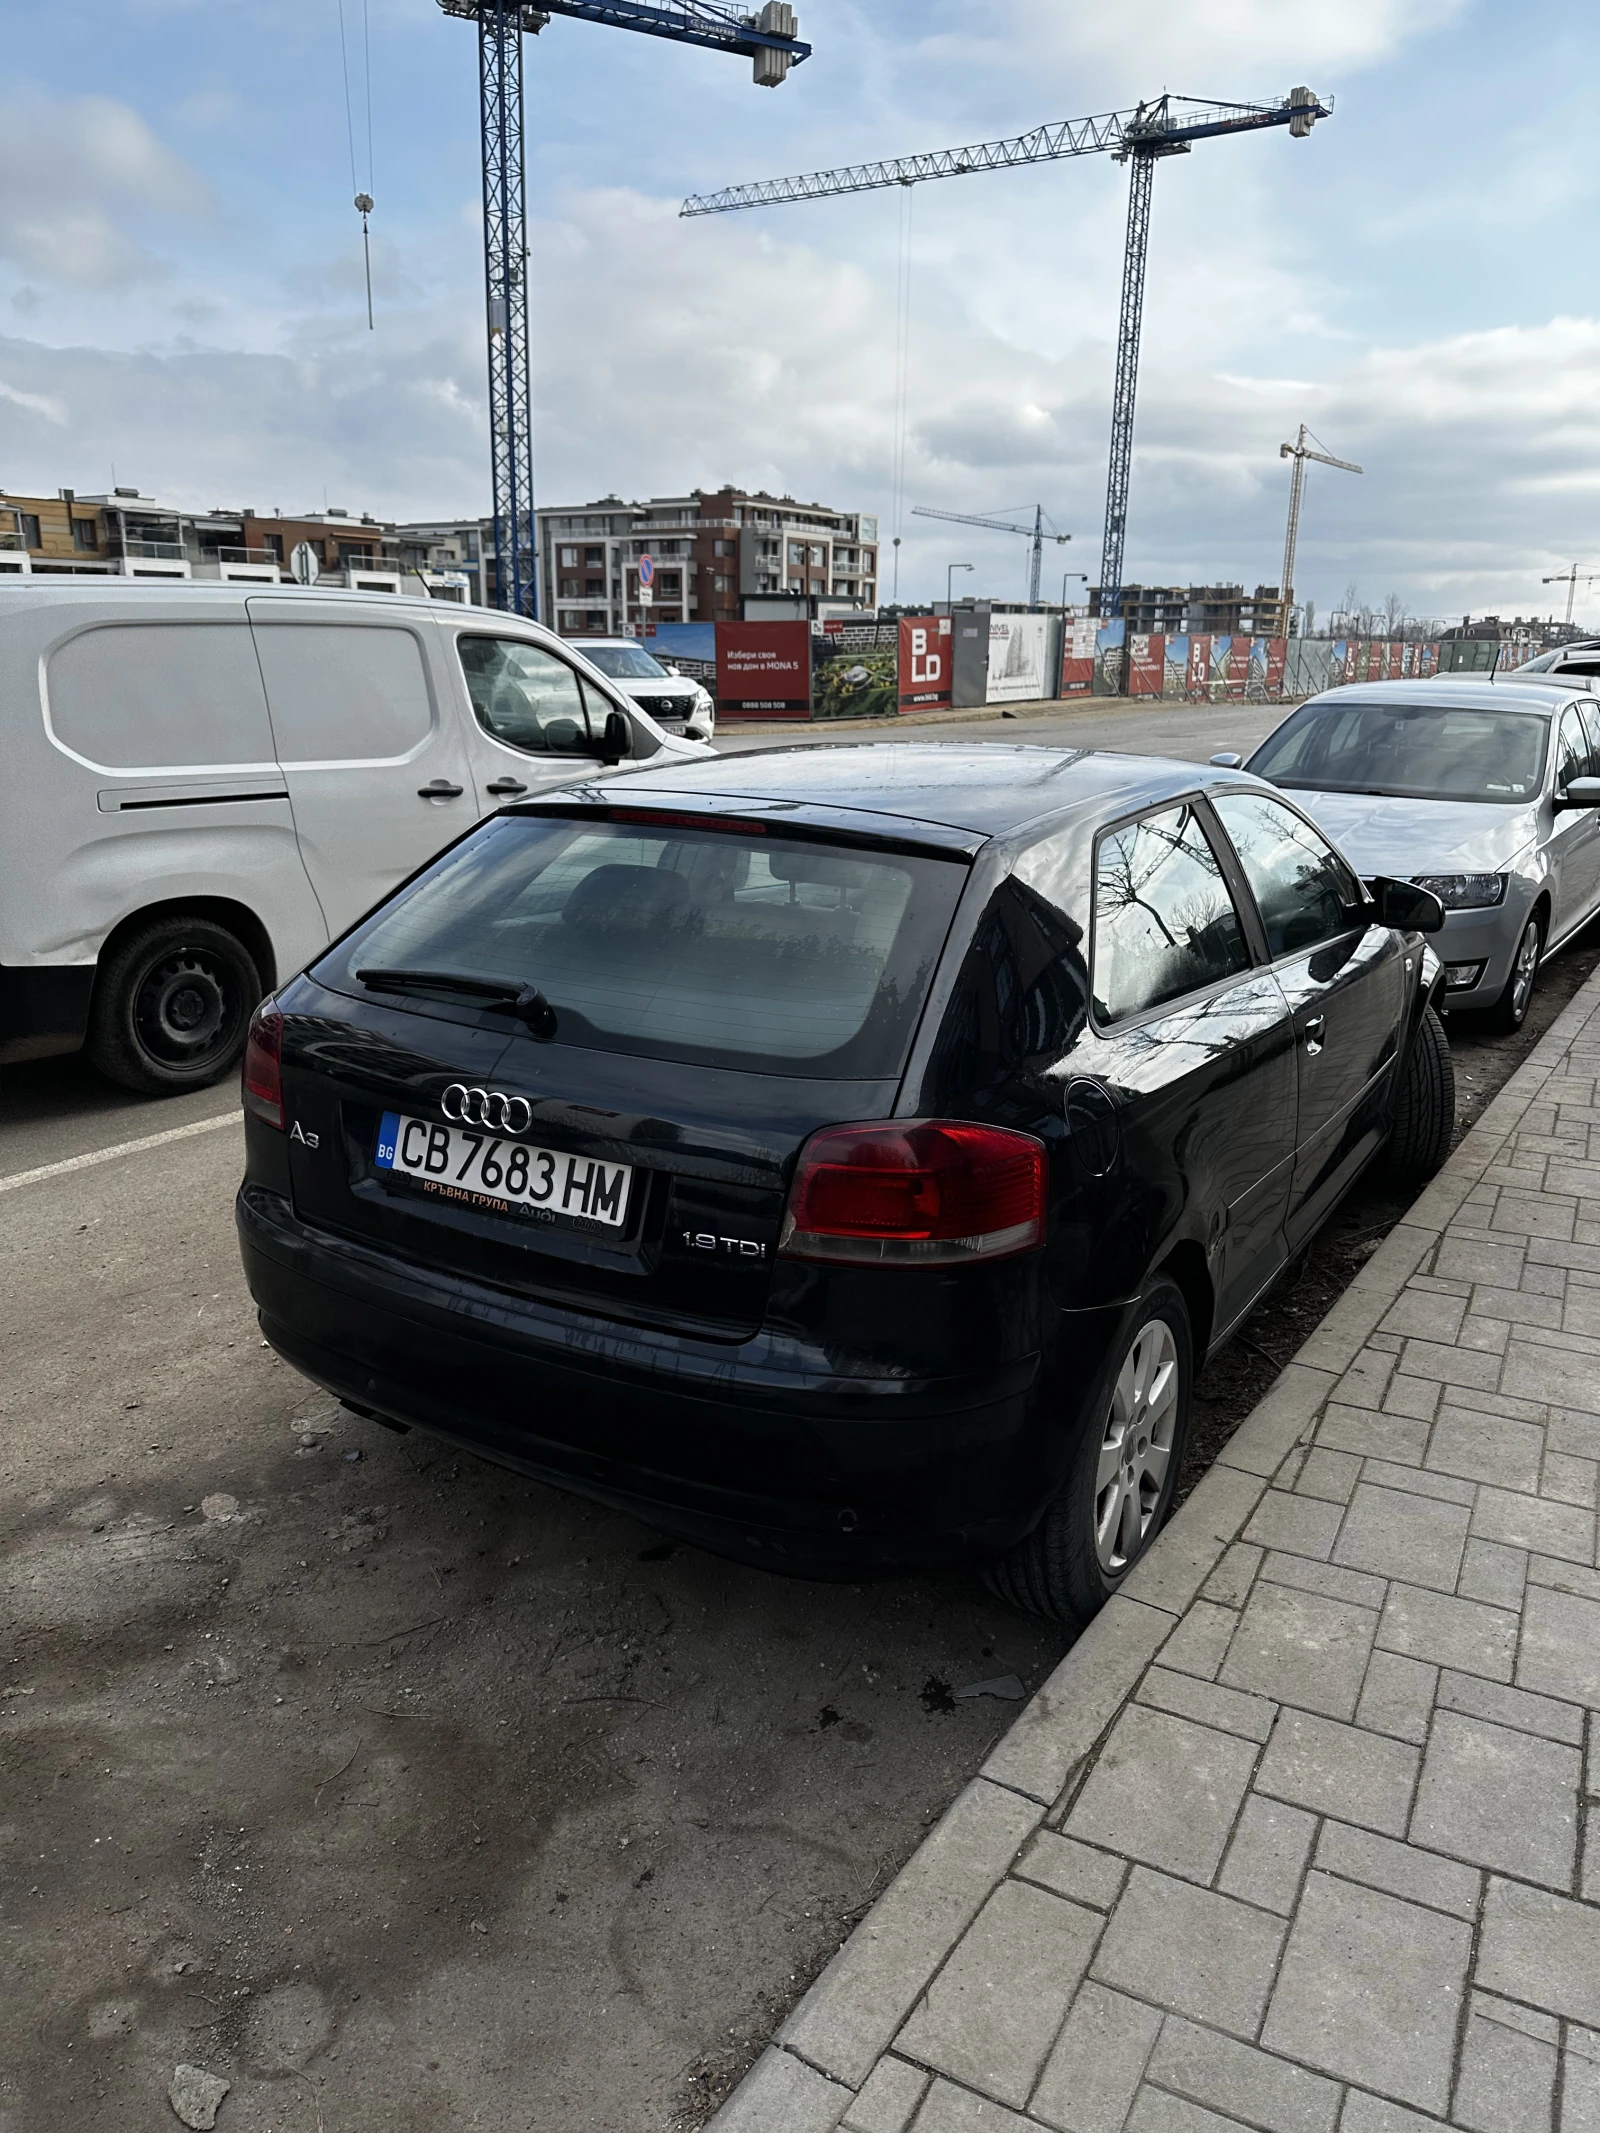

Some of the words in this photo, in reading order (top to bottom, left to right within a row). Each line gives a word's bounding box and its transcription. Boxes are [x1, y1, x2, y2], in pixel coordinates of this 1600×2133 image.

[727, 651, 756, 660] Избери
[743, 663, 759, 671] дом
[766, 661, 792, 670] MONA
[793, 661, 799, 670] 5
[290, 1120, 319, 1149] A3
[377, 1143, 394, 1160] BG
[423, 1180, 469, 1202] КРЪВНА
[472, 1193, 509, 1213] ГРУПА
[517, 1202, 556, 1224] Audi
[683, 1231, 716, 1250] 1.9
[720, 1237, 766, 1259] TDI
